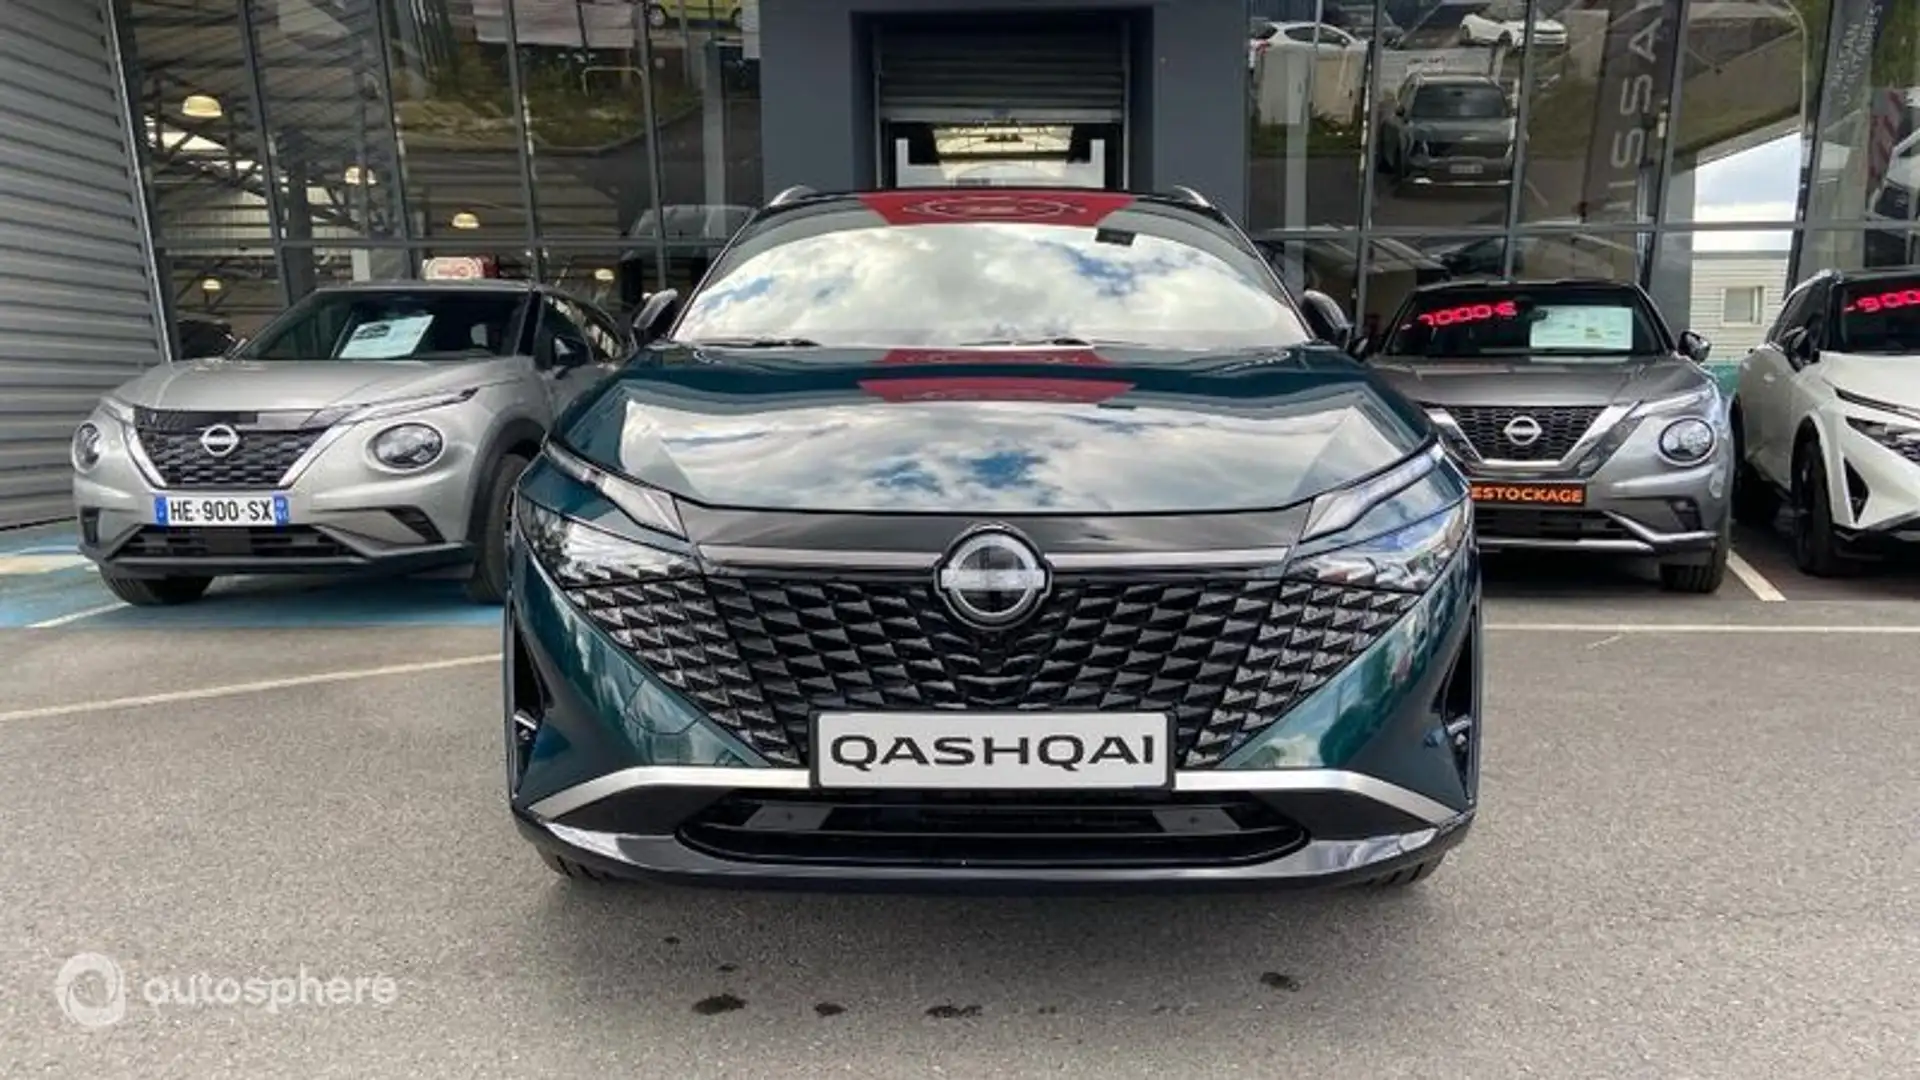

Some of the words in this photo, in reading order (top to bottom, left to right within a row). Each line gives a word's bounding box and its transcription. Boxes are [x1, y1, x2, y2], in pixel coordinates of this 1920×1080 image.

[1603, 16, 1663, 213] ISSA
[1471, 485, 1584, 504] ESTOCKAGE
[170, 499, 273, 522] HE-900-SX
[830, 734, 1154, 772] QASHQAI
